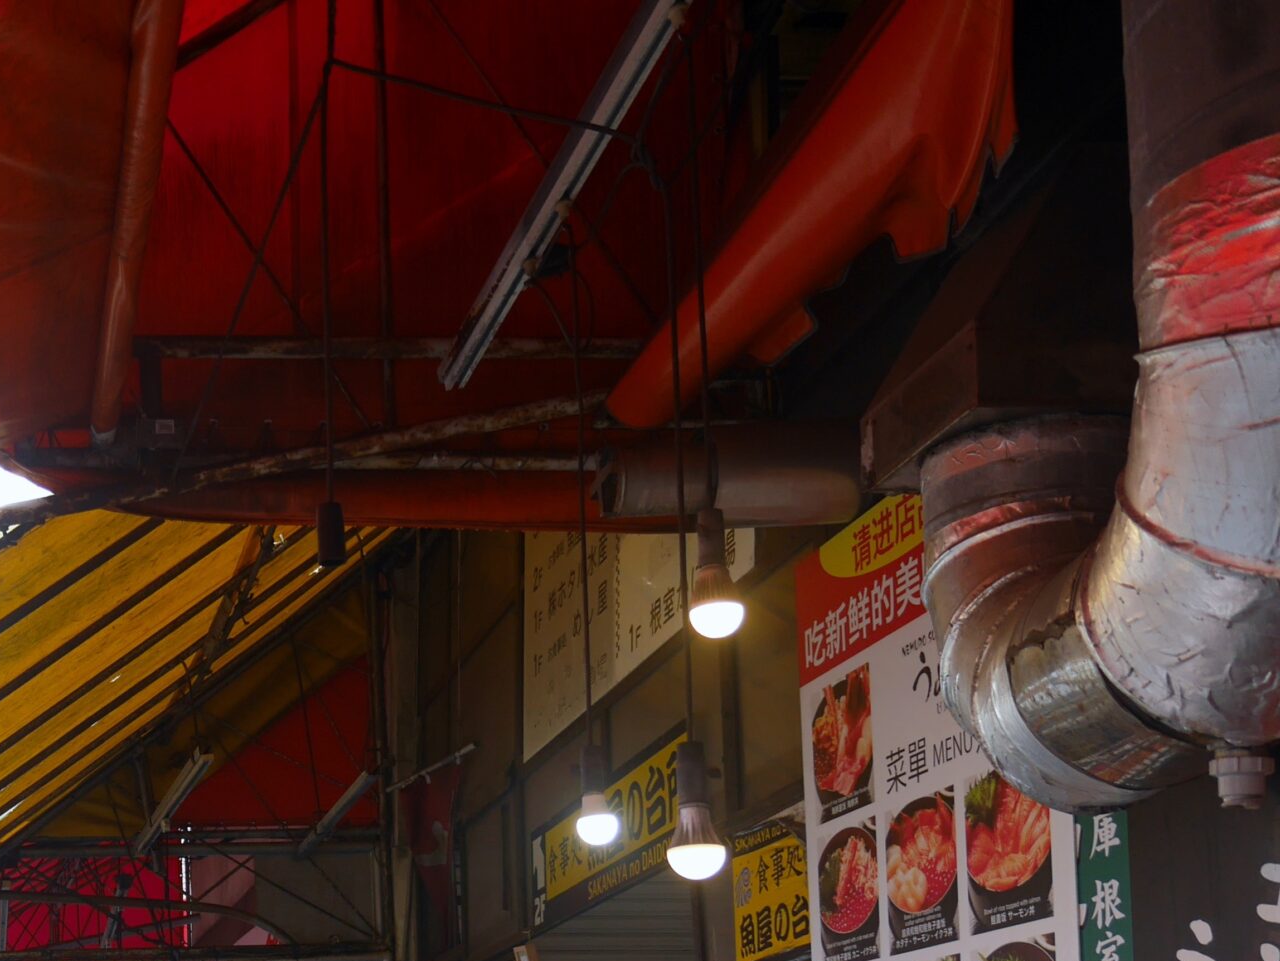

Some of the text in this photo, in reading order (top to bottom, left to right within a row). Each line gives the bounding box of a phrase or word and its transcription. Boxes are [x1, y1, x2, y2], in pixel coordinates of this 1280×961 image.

[804, 554, 926, 669] 吃新鲜的美
[885, 737, 928, 794] 菜單
[933, 730, 973, 767] MENU
[588, 866, 628, 900] SAKANAYA
[756, 845, 803, 894] 食事処
